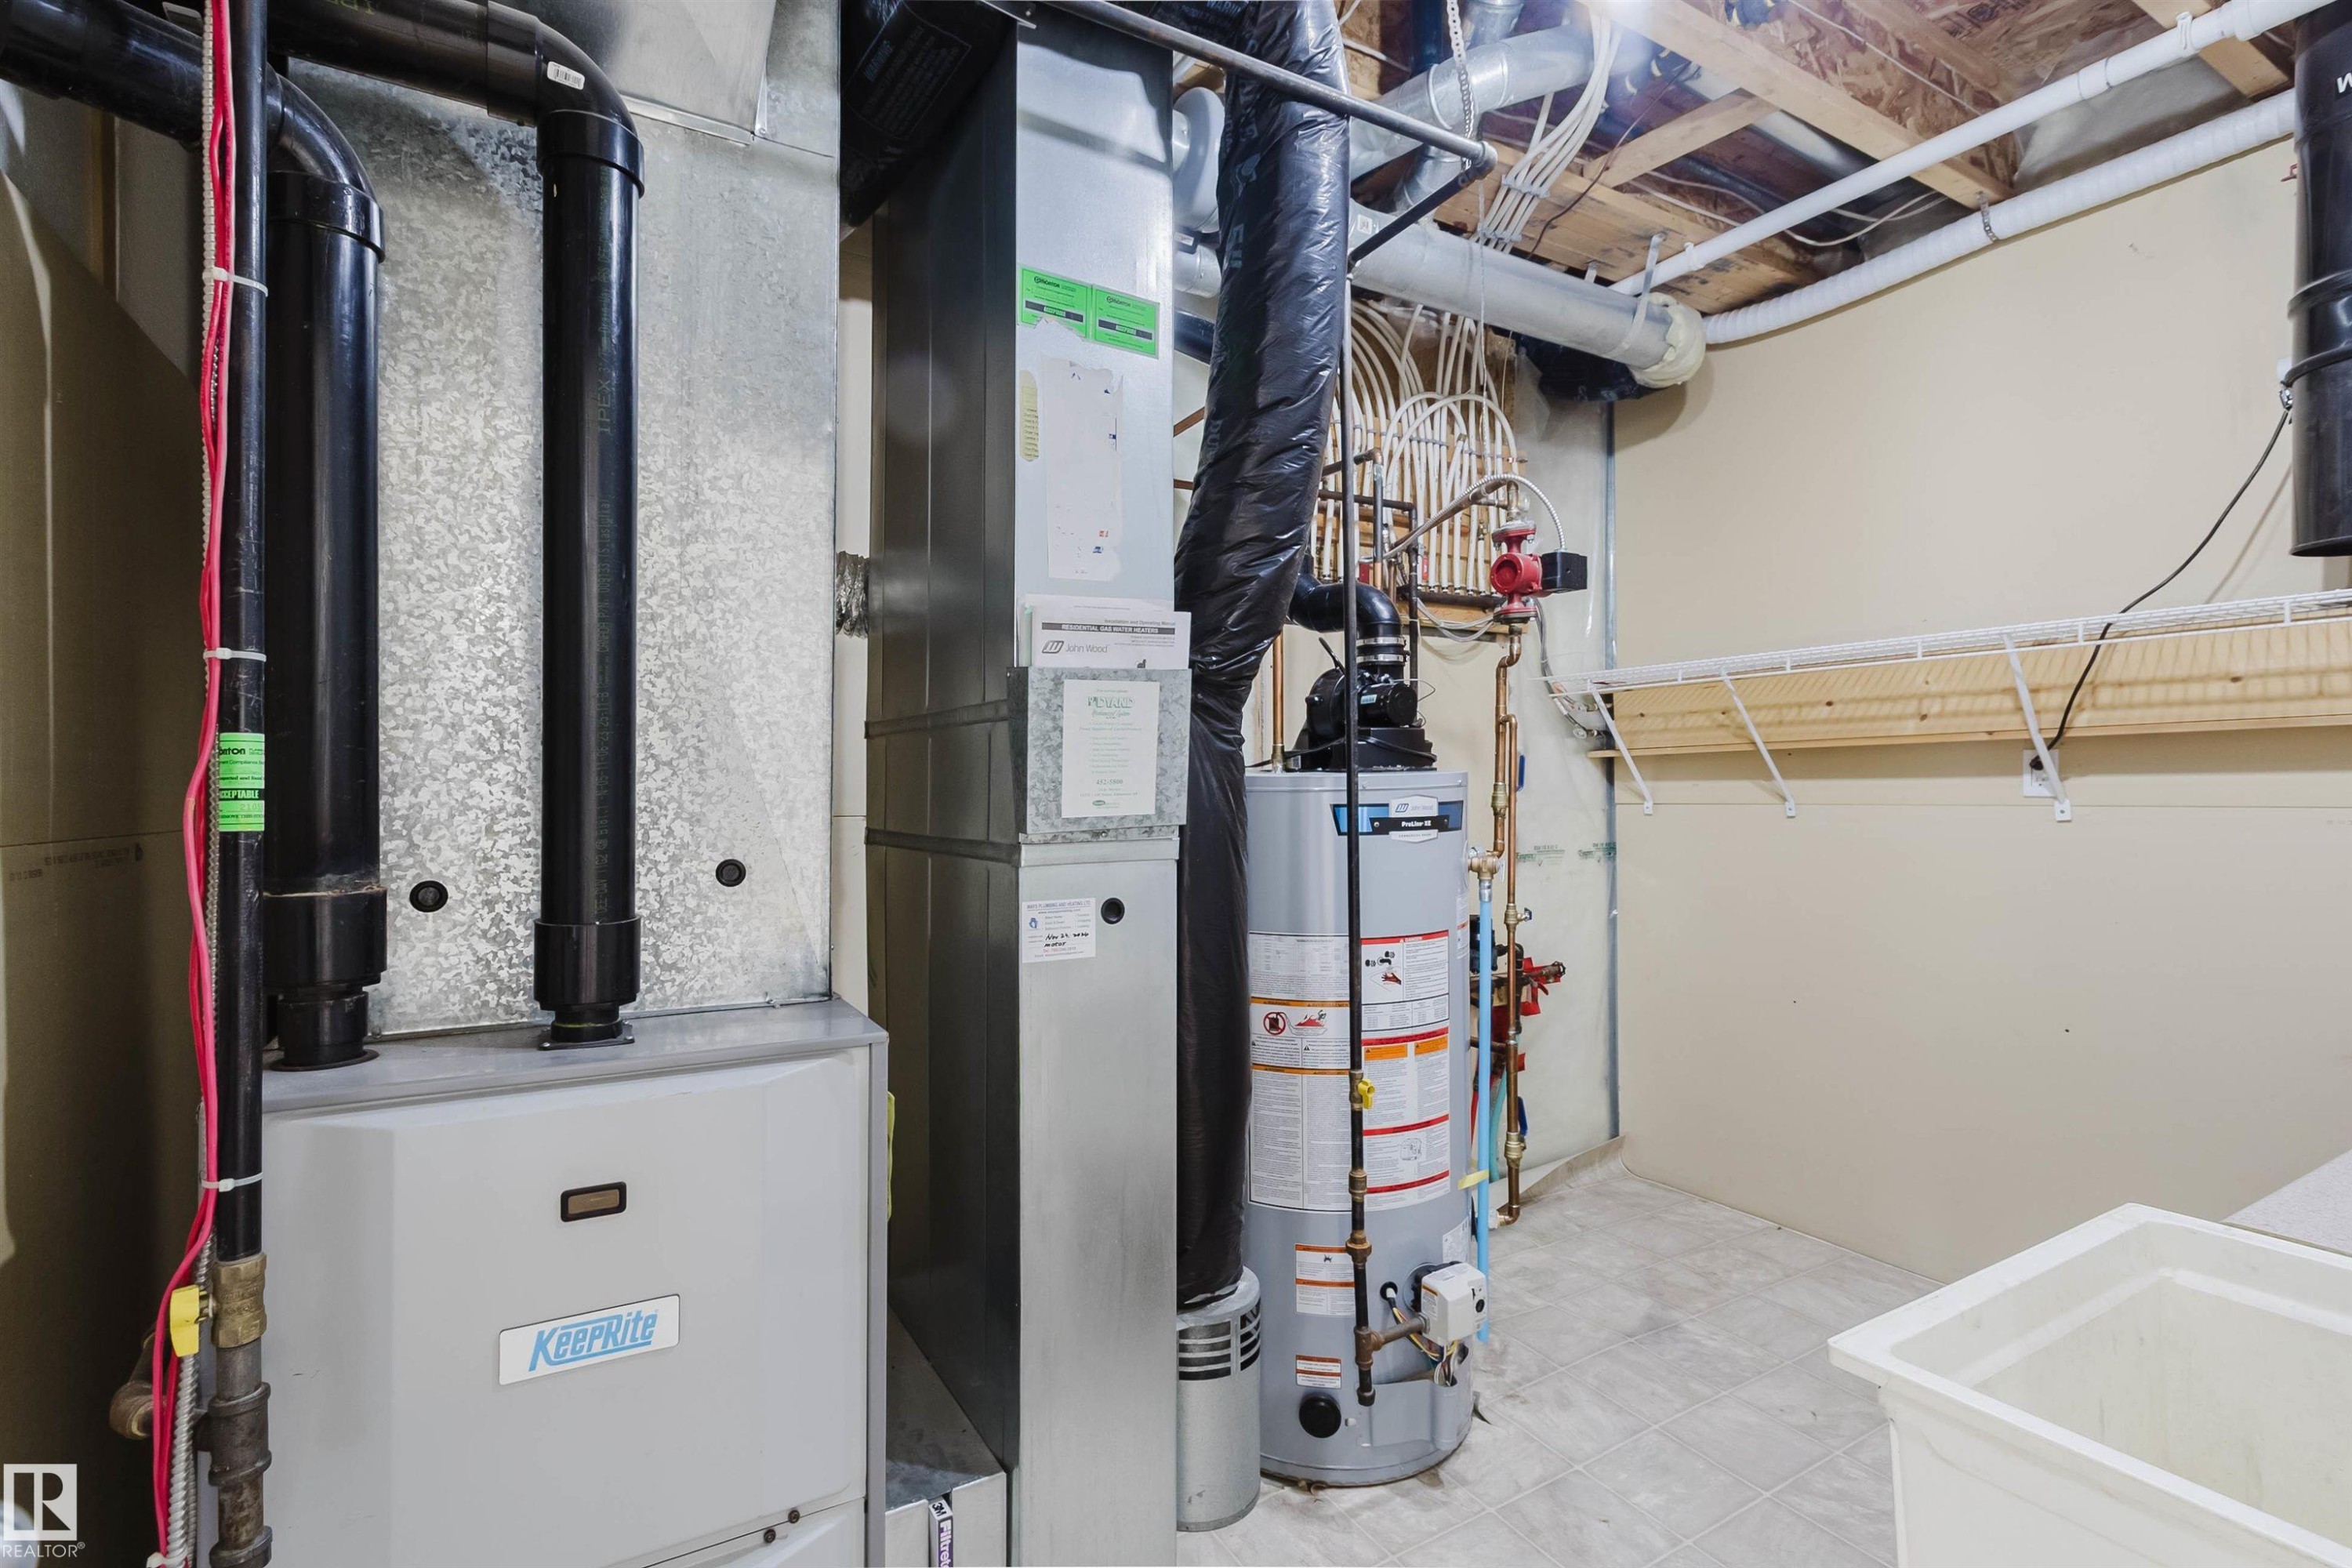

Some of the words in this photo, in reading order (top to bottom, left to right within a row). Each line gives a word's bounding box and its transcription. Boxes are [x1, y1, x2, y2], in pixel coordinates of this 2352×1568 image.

[1065, 644, 1083, 654] John
[1086, 644, 1108, 653] Wood
[932, 1502, 947, 1517] 3M
